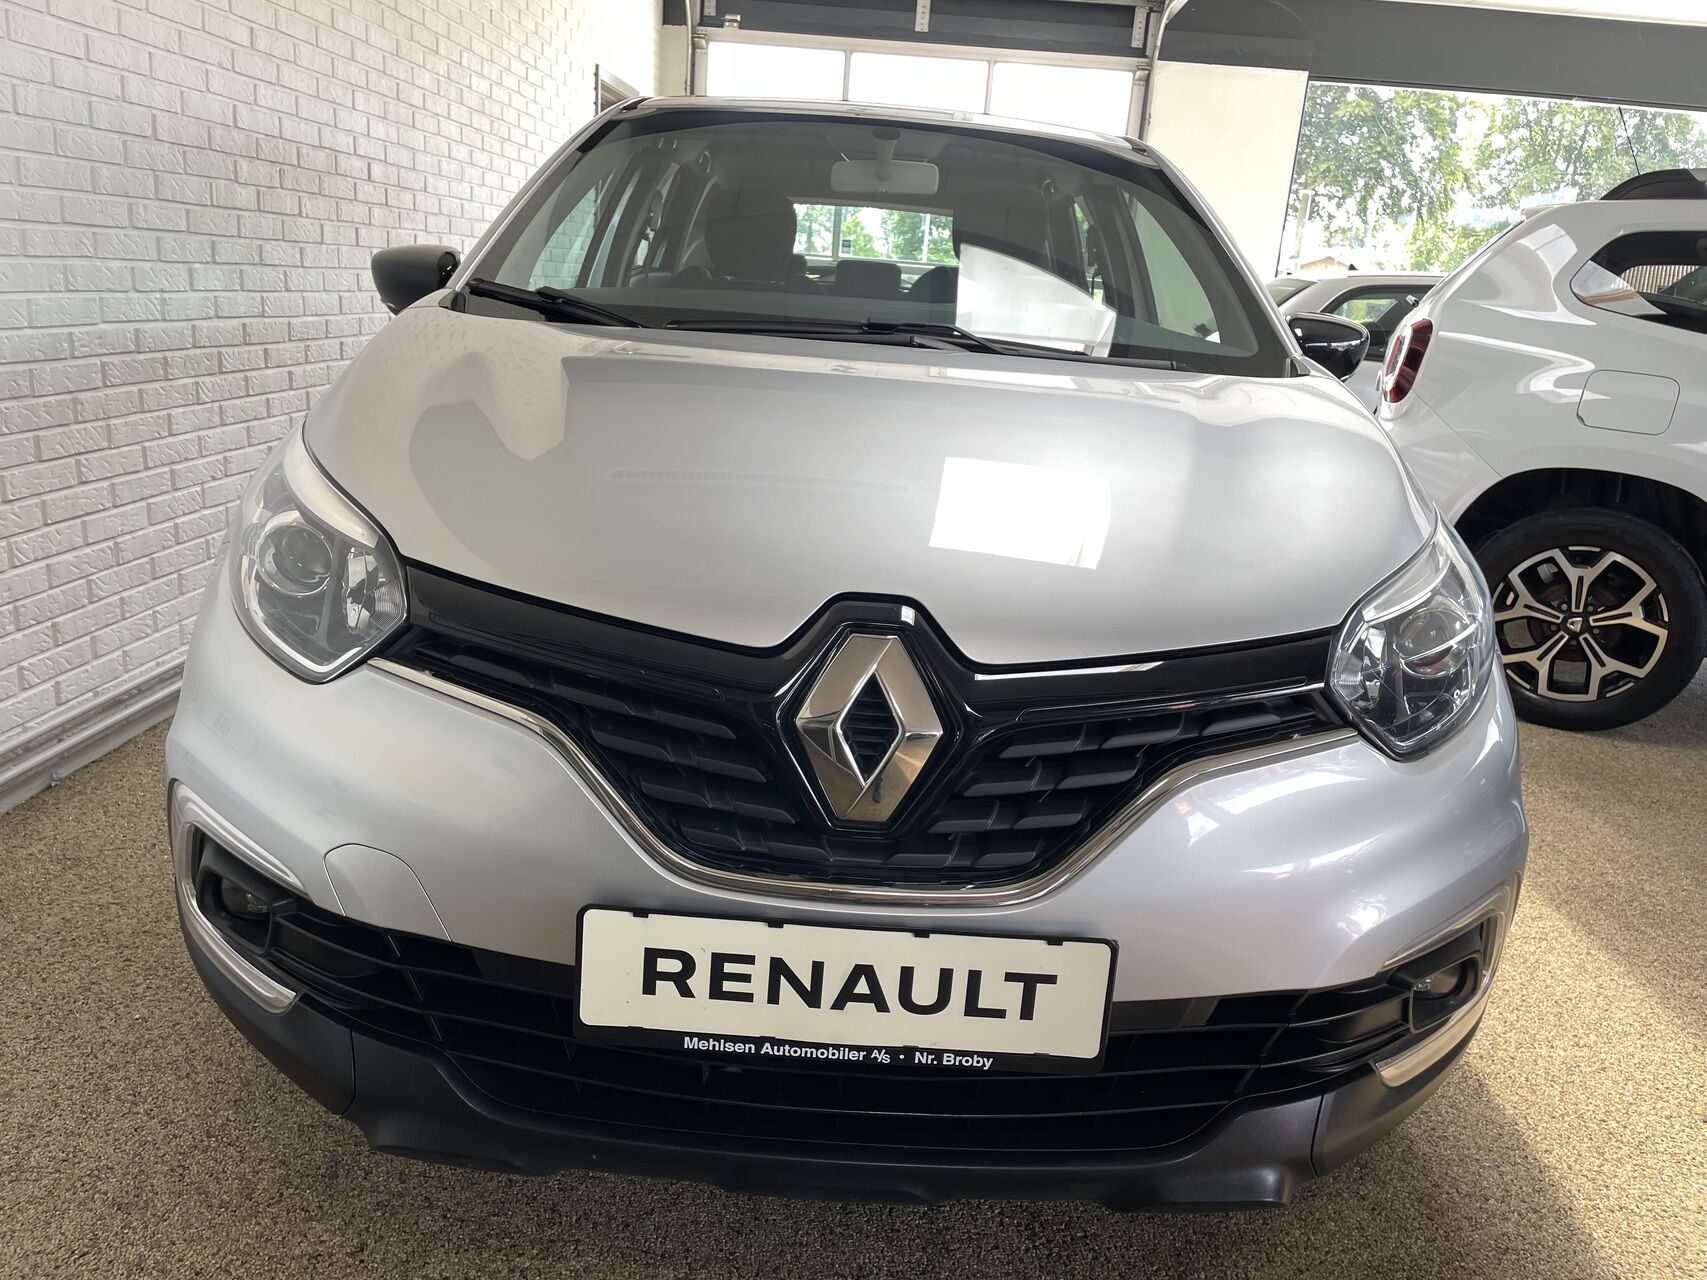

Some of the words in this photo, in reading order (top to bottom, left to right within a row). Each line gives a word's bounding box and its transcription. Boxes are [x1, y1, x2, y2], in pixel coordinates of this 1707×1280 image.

[641, 946, 1059, 1021] RENAULT
[683, 1036, 756, 1054] Mehlsen
[760, 1042, 867, 1062] Automobiler
[914, 1052, 938, 1065] Nr.
[942, 1053, 994, 1070] Broby
